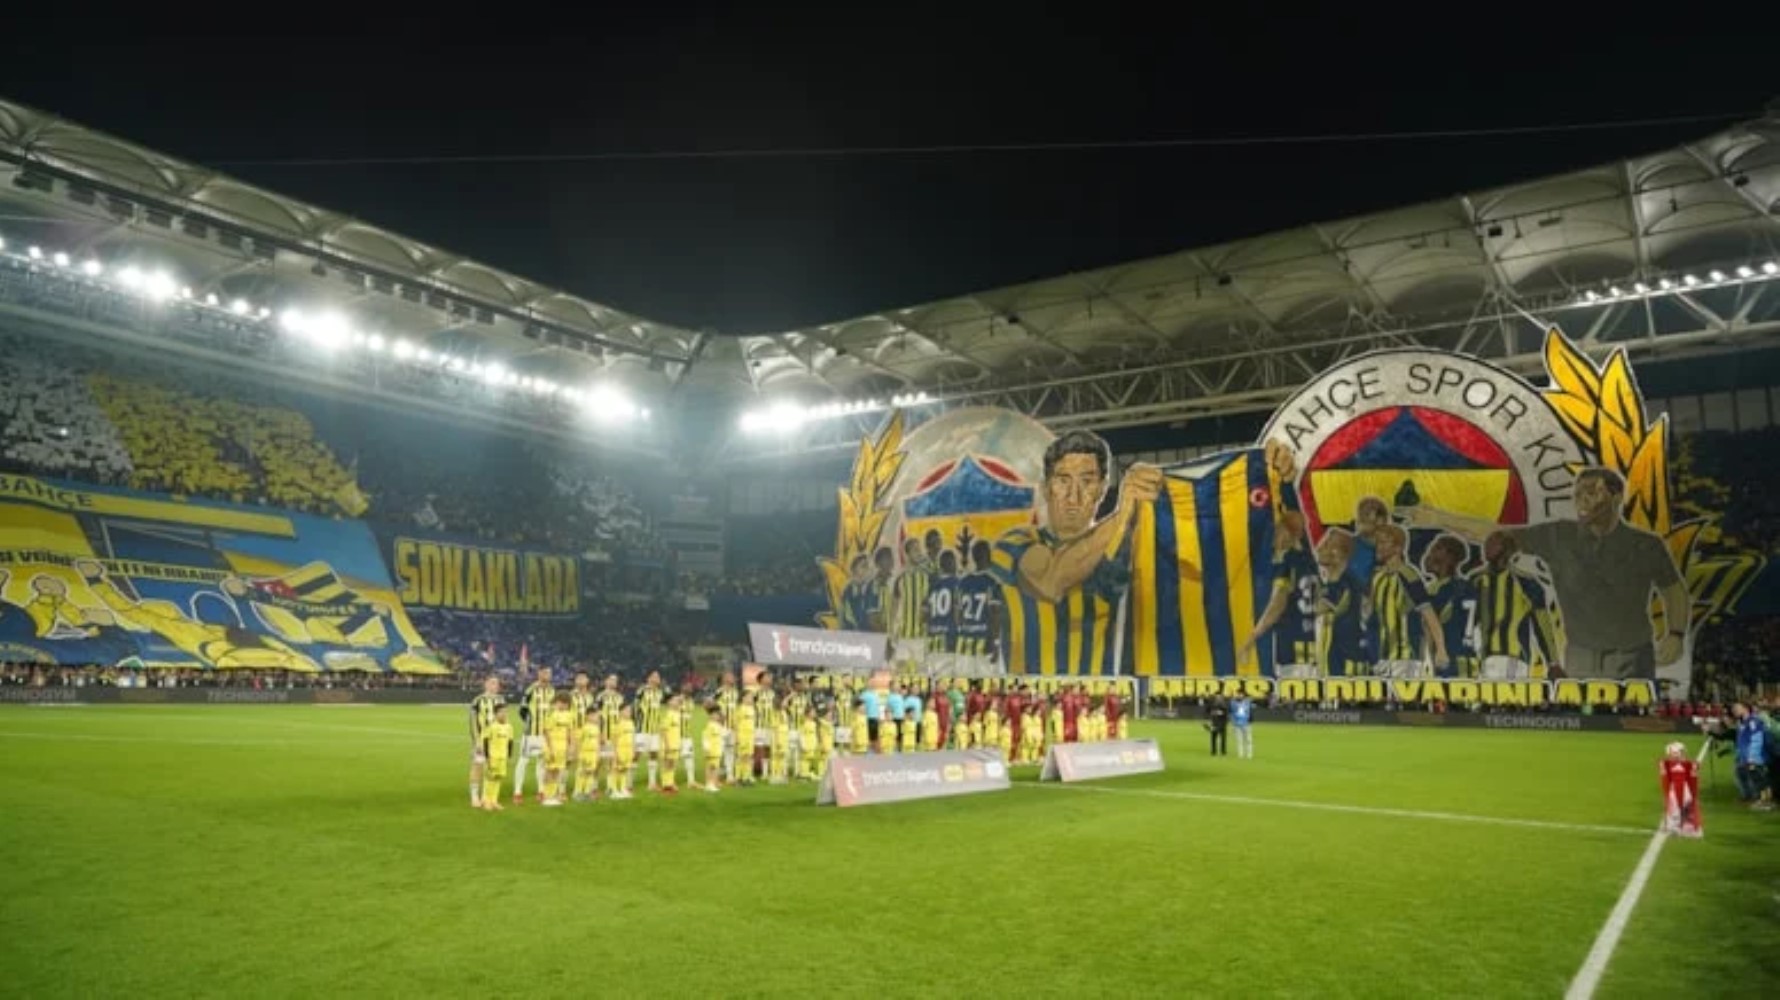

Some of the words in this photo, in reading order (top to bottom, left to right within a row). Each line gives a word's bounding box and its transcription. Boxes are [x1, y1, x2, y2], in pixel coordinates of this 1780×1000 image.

[1406, 363, 1529, 431] SPOR
[396, 539, 579, 612] SOKAKLARA
[929, 588, 952, 618] 10
[961, 592, 987, 621] 27
[1485, 714, 1581, 729] TECHNOGYM
